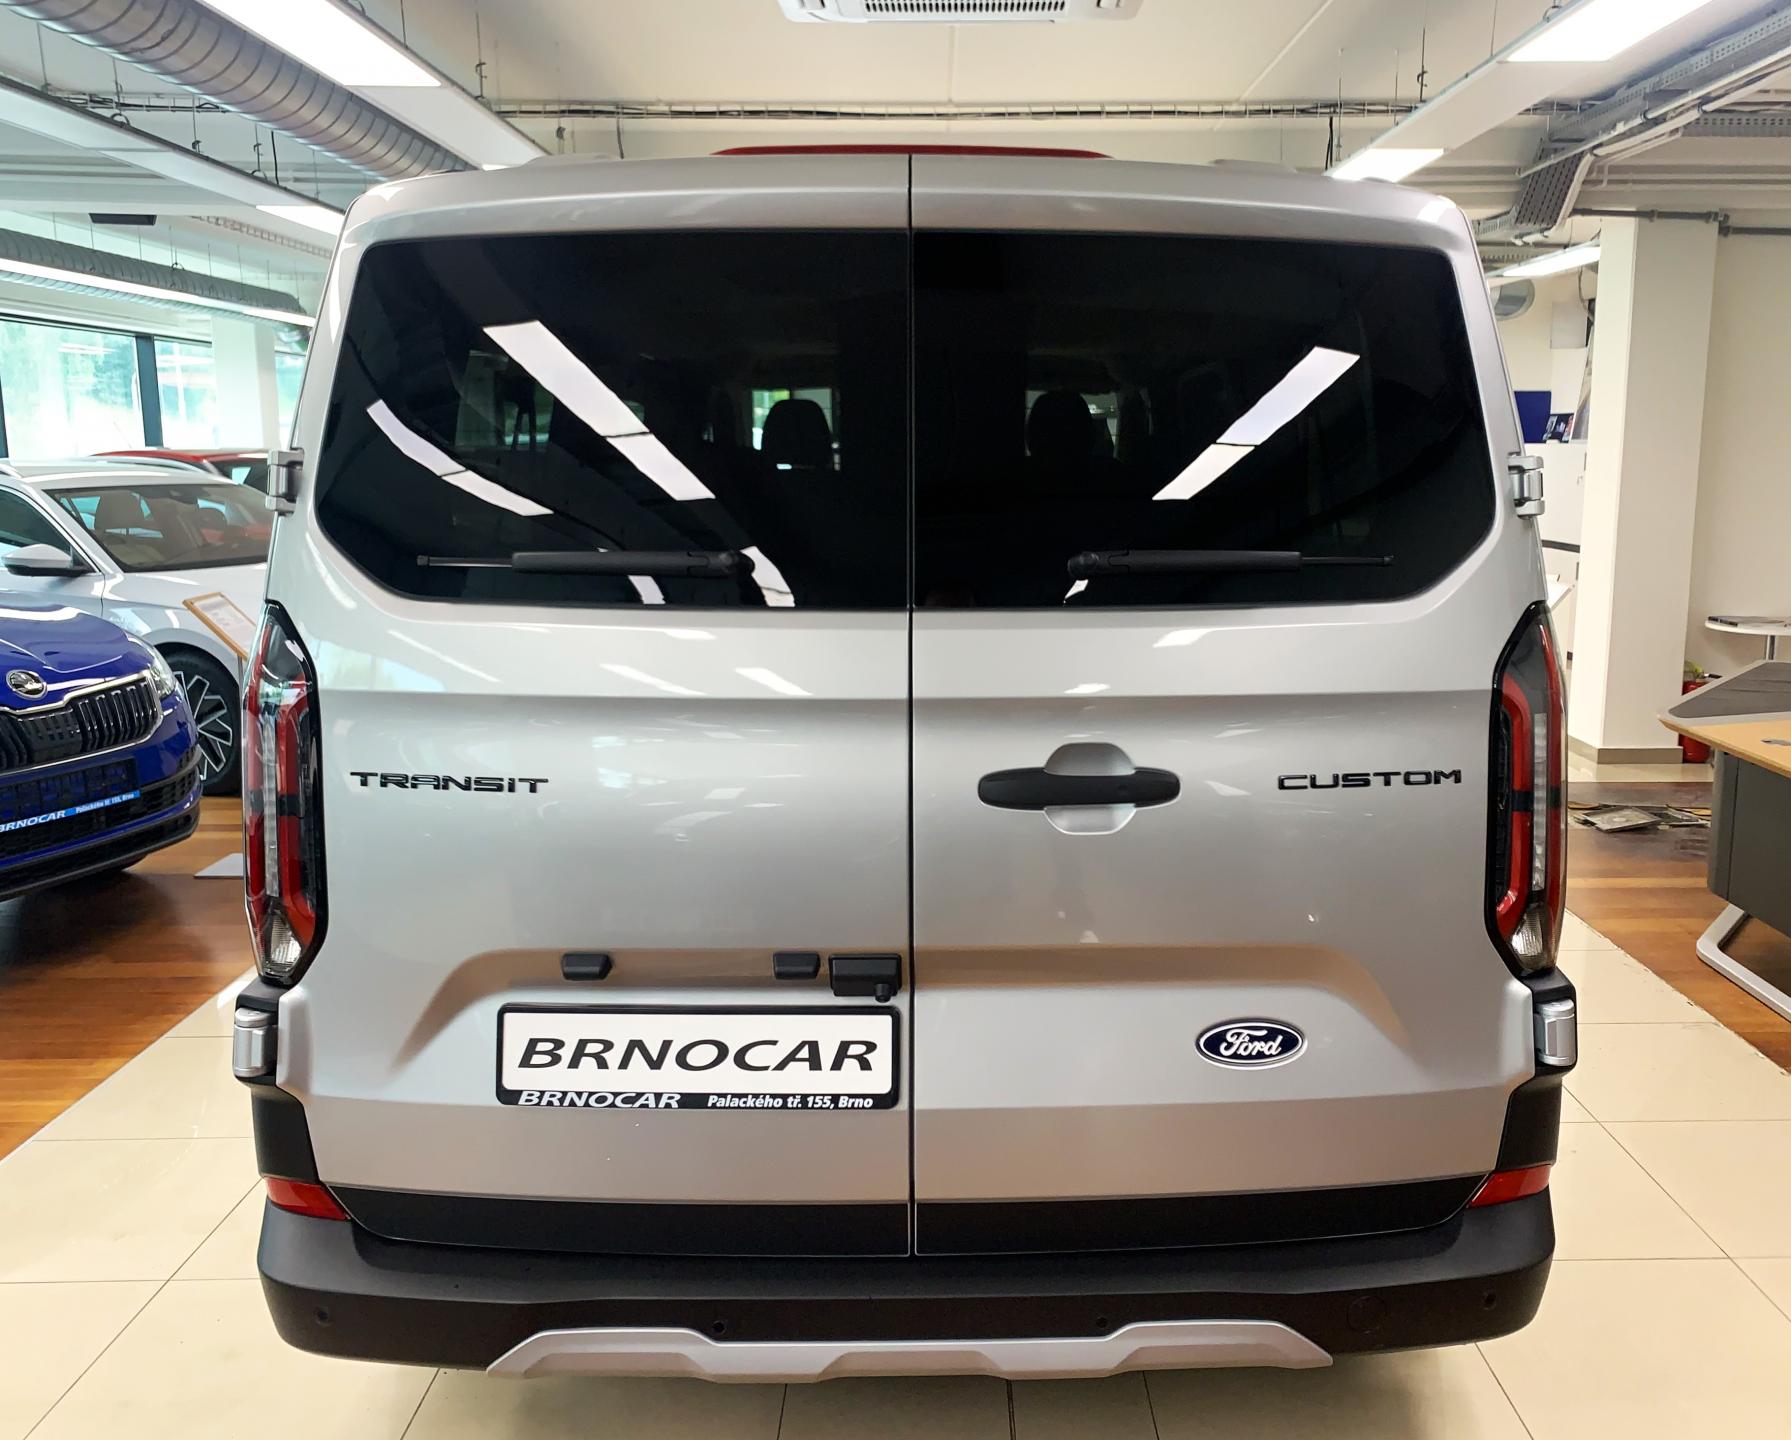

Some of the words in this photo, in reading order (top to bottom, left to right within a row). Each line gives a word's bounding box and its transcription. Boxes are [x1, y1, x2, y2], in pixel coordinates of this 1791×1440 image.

[350, 771, 549, 794] TRANSIT
[1277, 769, 1462, 790] CUSTOM
[1219, 1028, 1284, 1057] Ford
[517, 1037, 879, 1072] BRNOCAR
[517, 1090, 682, 1109] BRNOCAR
[707, 1094, 783, 1109] Palackého
[786, 1095, 802, 1108] tř.
[806, 1096, 835, 1110] 155,
[838, 1096, 874, 1109] Brno
